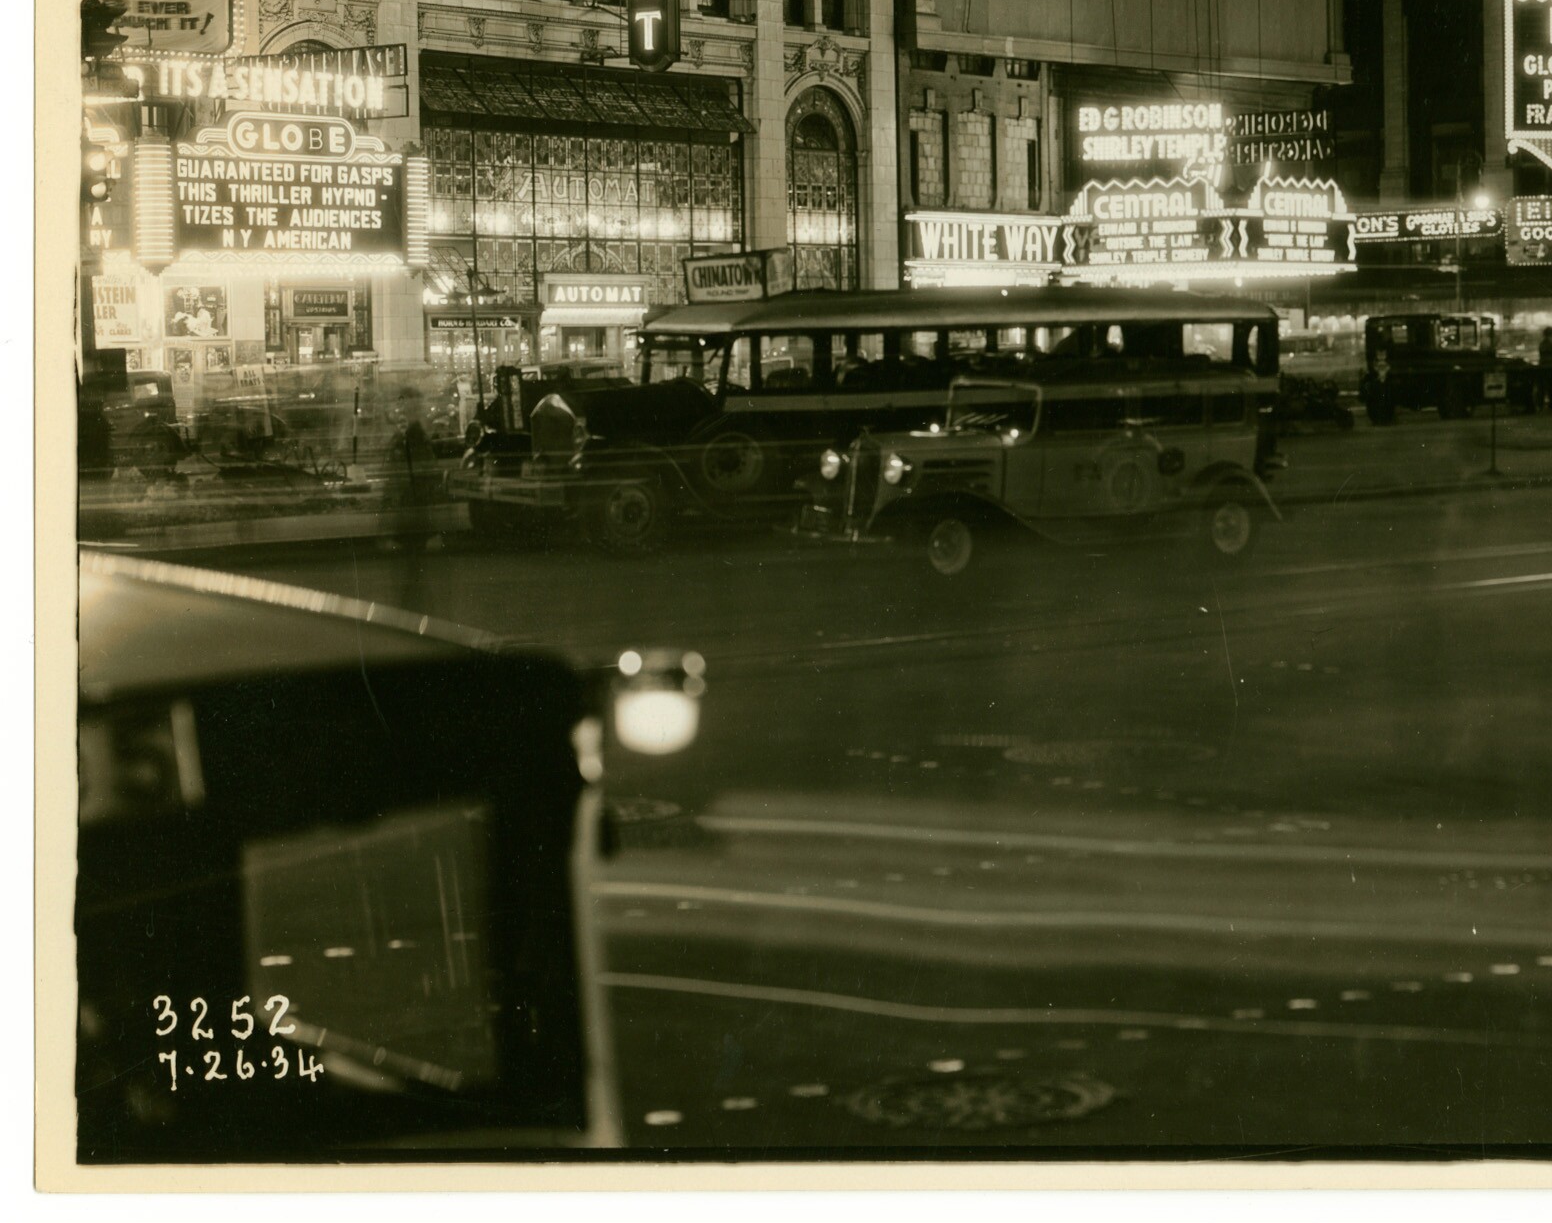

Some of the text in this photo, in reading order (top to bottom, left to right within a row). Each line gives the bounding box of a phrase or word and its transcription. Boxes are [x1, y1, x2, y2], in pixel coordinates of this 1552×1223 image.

[235, 64, 385, 111] SENSATION
[1121, 103, 1222, 130] ROBINSON
[235, 122, 347, 153] GLOBE
[177, 159, 394, 186] GUARANTEED FOR GASPS
[177, 182, 217, 203] THIS
[229, 183, 312, 206] THRILLER
[516, 171, 655, 203] AUTOMAT
[183, 205, 382, 229] TIZES THE AUDIENCES
[1093, 191, 1199, 220] CENTRAL
[222, 229, 352, 250] N Y AMERICAN
[919, 222, 998, 260] WHITE
[1003, 225, 1058, 262] WAY
[554, 285, 642, 303] AUTOMAT
